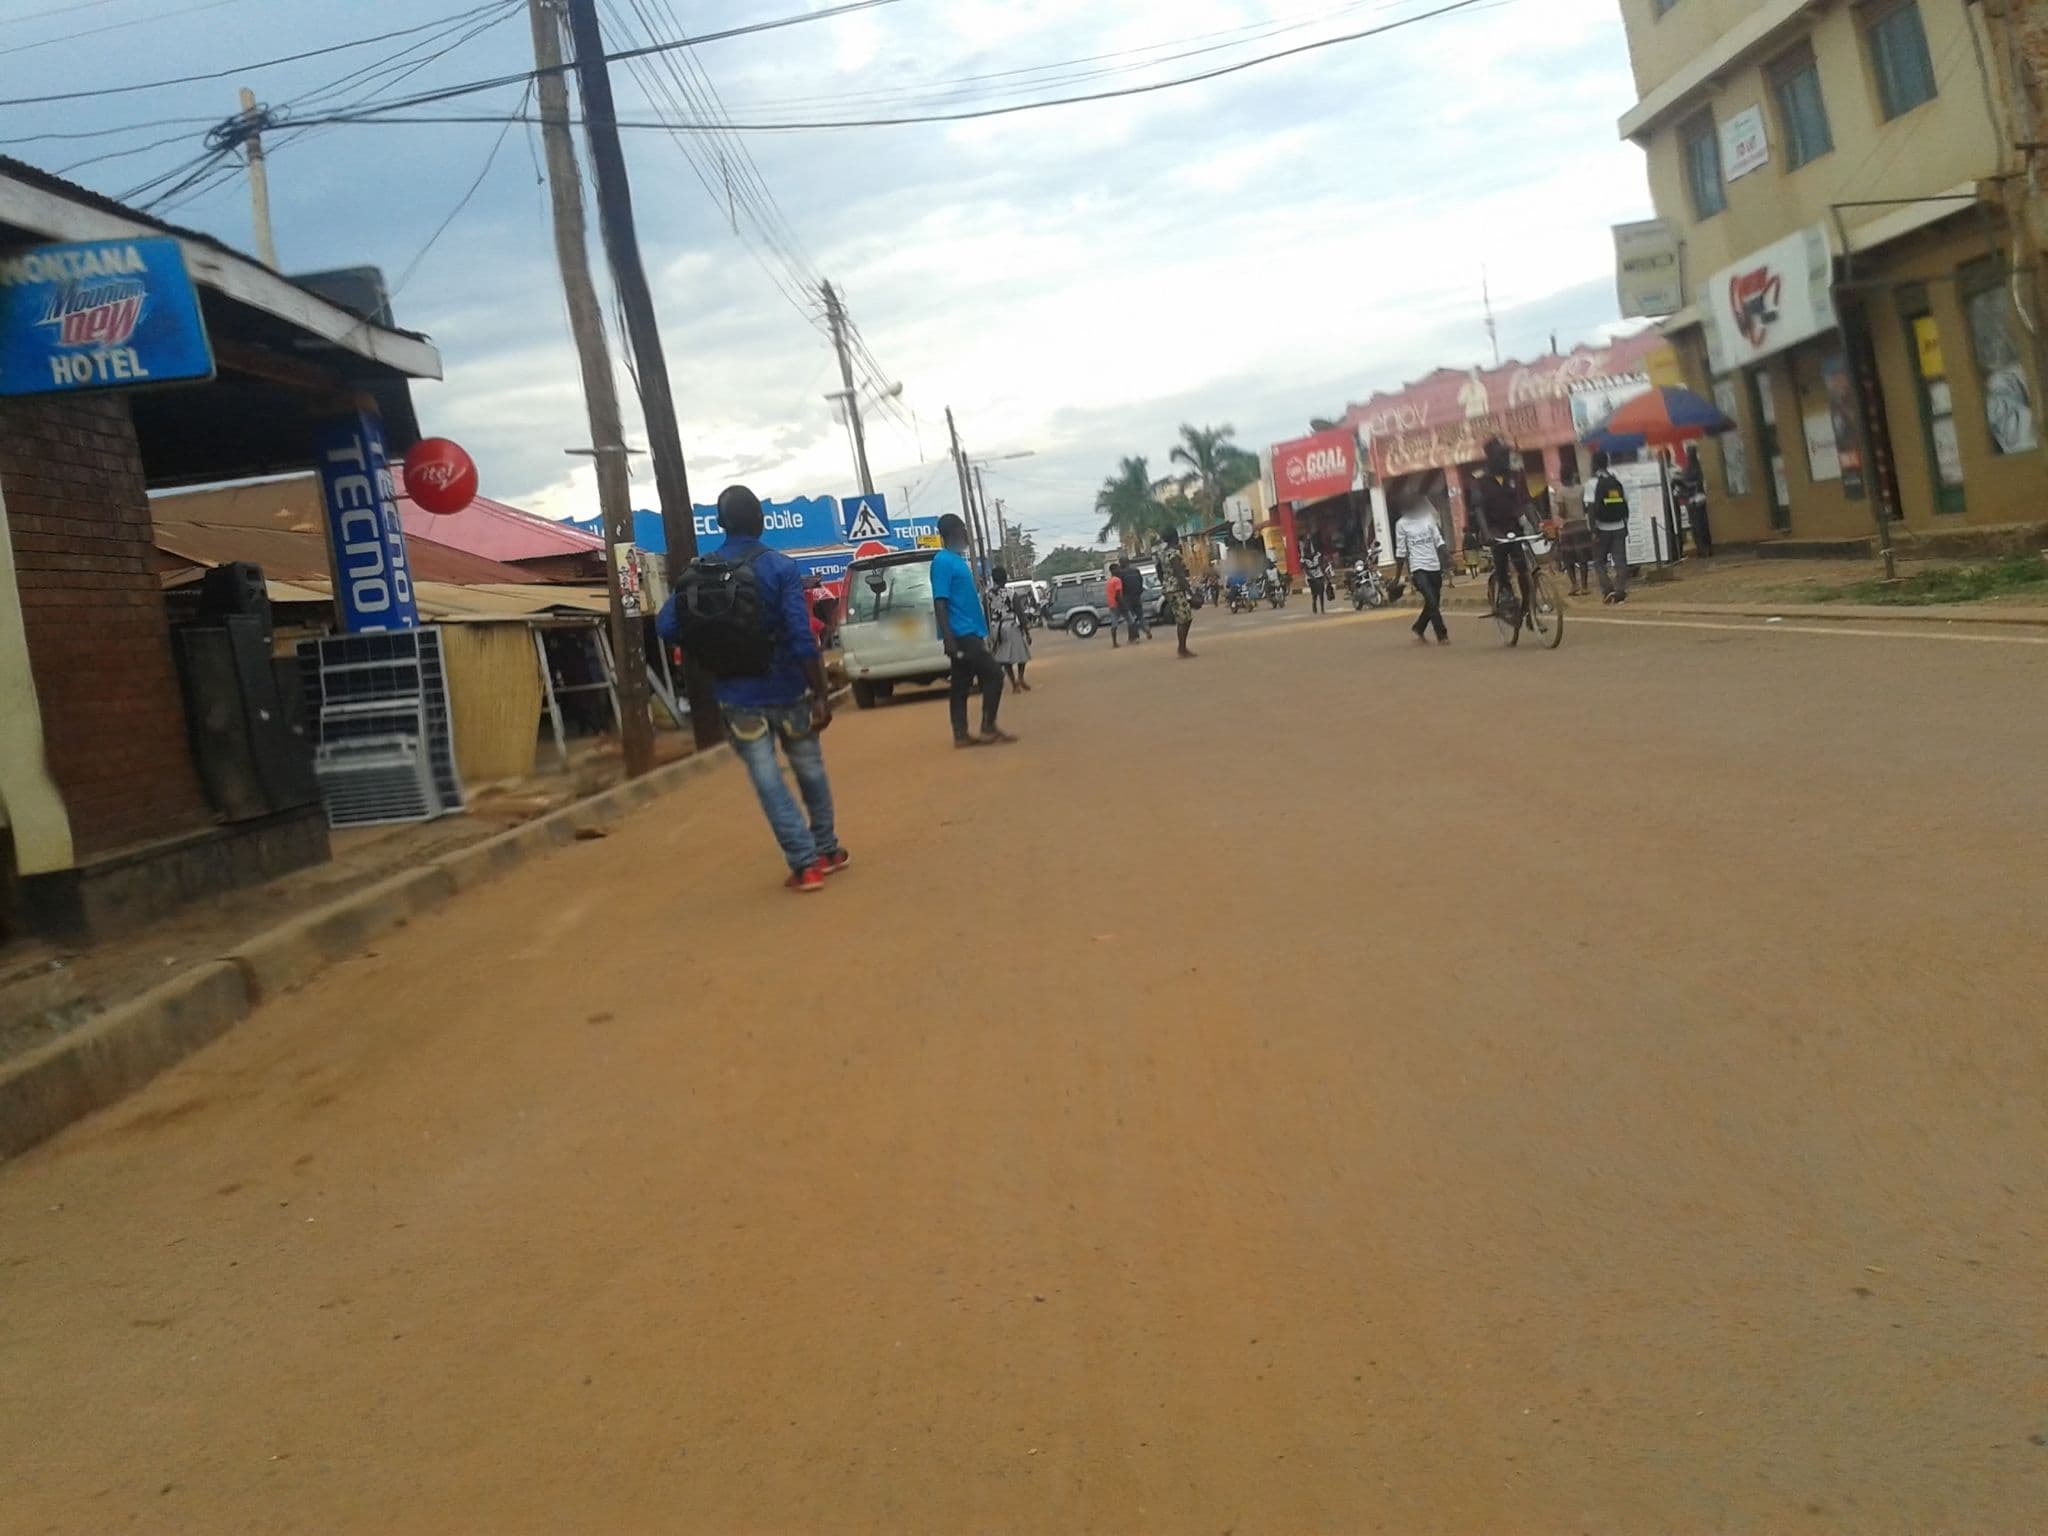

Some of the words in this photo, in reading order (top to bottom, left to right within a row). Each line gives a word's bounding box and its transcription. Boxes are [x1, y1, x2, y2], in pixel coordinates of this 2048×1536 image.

[51, 349, 149, 385] HOTEL
[1306, 445, 1347, 476] GOAL
[326, 433, 391, 614] TECNO
[763, 510, 805, 531] obile
[894, 524, 931, 539] TECNO
